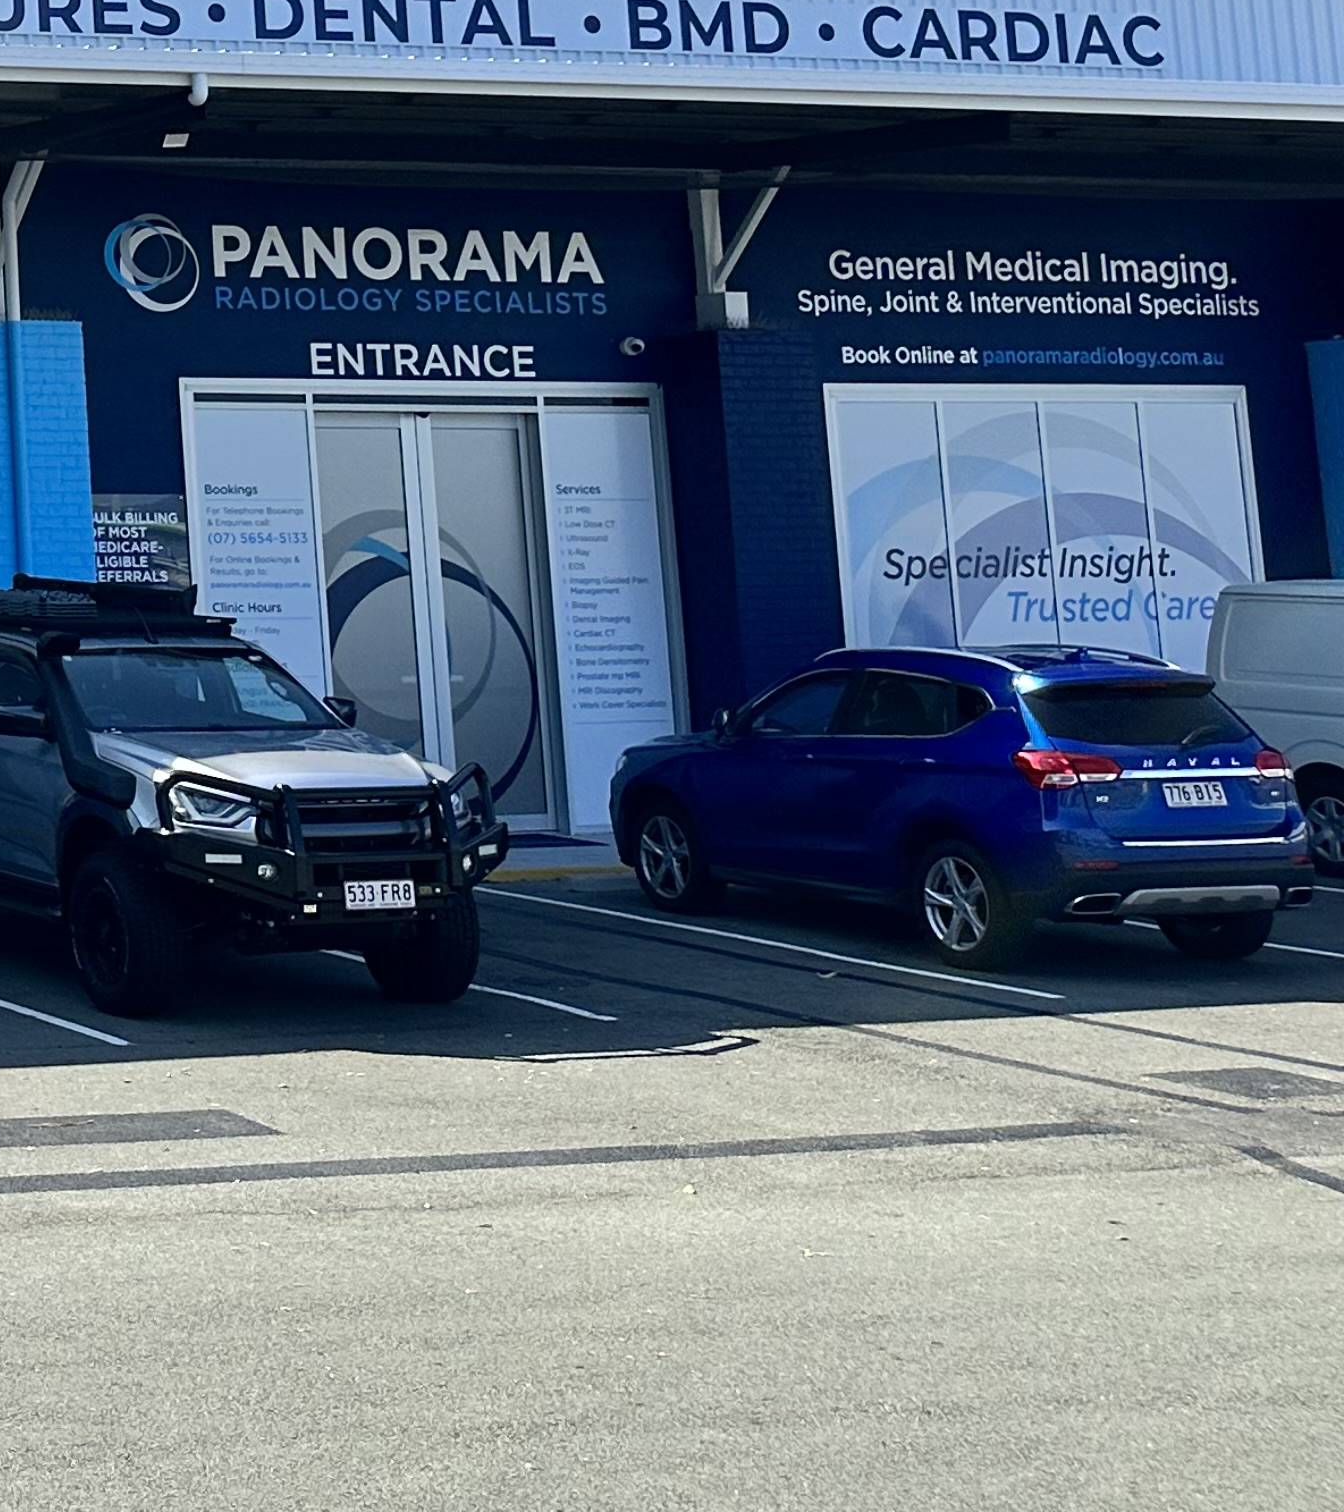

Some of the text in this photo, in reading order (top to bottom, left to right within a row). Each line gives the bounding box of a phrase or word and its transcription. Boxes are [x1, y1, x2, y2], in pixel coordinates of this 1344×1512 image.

[863, 6, 1164, 66] CARDIAC
[212, 224, 604, 284] PANORAMA
[829, 249, 1237, 290] General Medical Imaging.
[216, 287, 608, 315] RADIOLOGY SPECIALISTS
[798, 289, 1260, 319] Spine, Joint & Interventional Specialists
[310, 343, 536, 378] ENTRANCE
[841, 345, 1225, 368] Book Online at panoramaradiology.com.au
[204, 484, 258, 497] Bookings
[555, 484, 601, 495] Services
[94, 512, 178, 524] ULK BILLING
[108, 526, 147, 538] MOST
[208, 532, 308, 545] (07) 5654-5133
[94, 541, 164, 553] EDICARE-
[97, 556, 149, 568] LIGIBLE
[883, 545, 1176, 586] Specialist Insight.
[98, 570, 168, 582] EFERRALS
[212, 602, 282, 613] Clinic Hours
[1008, 589, 1132, 622] Trusted
[1143, 757, 1240, 768] HAVAL
[1165, 785, 1191, 801] 776
[347, 884, 411, 902] 533 FR8
